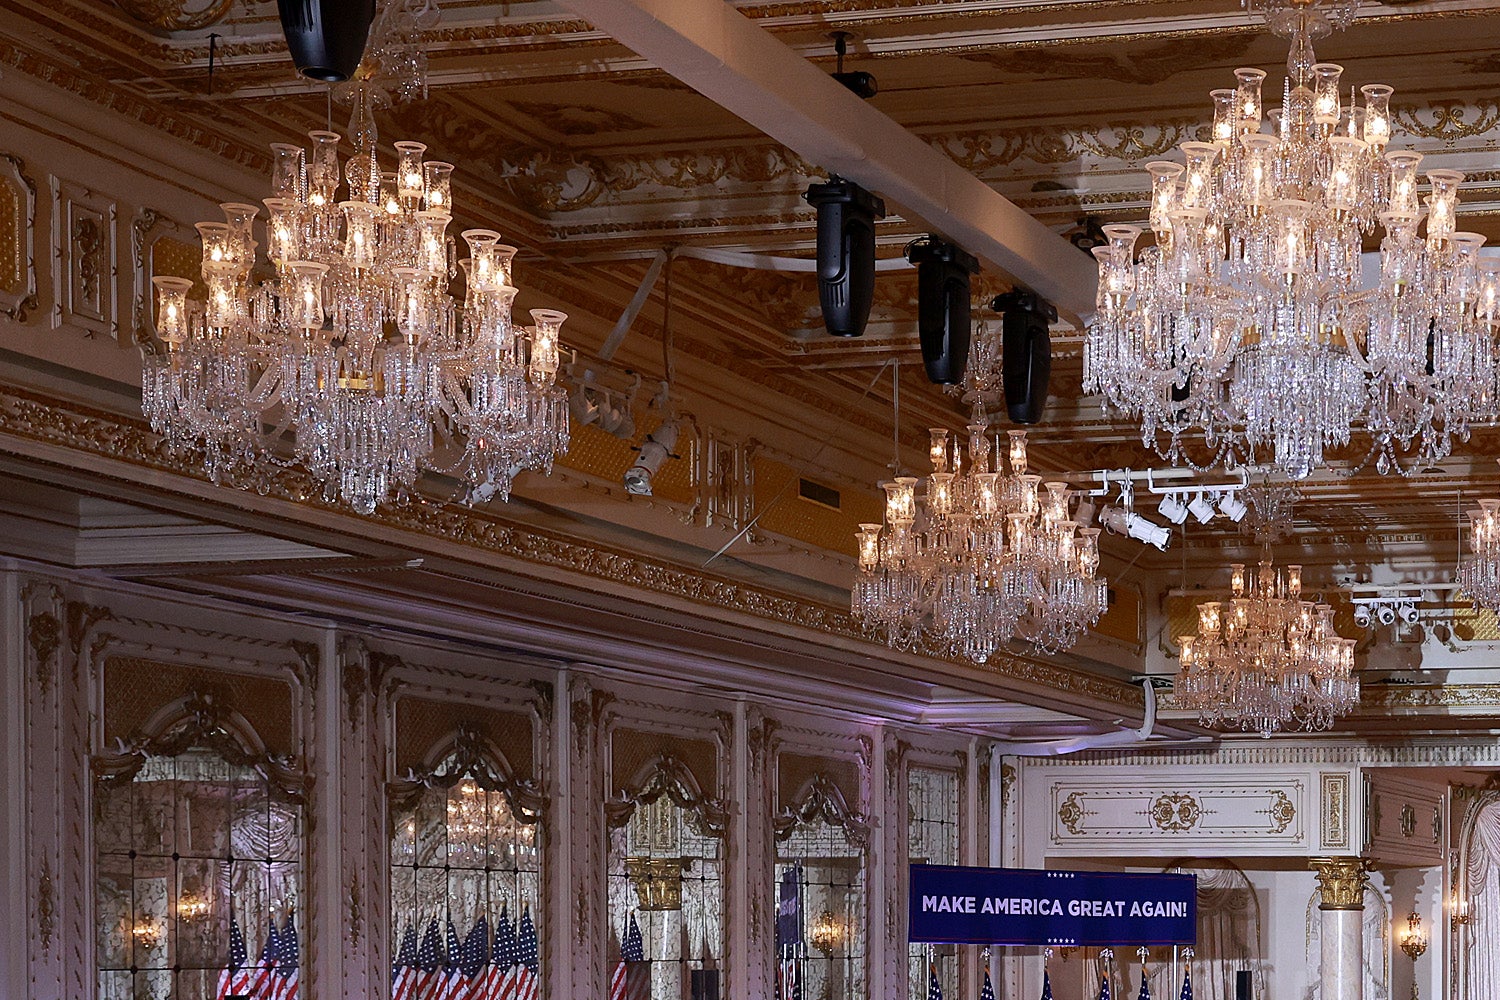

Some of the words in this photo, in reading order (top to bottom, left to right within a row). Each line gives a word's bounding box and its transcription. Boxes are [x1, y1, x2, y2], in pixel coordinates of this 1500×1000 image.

[922, 895, 976, 914] MAKE
[981, 897, 1063, 916] AMERICA
[1068, 899, 1126, 917] GREAT
[1129, 901, 1187, 917] AGAIN!
